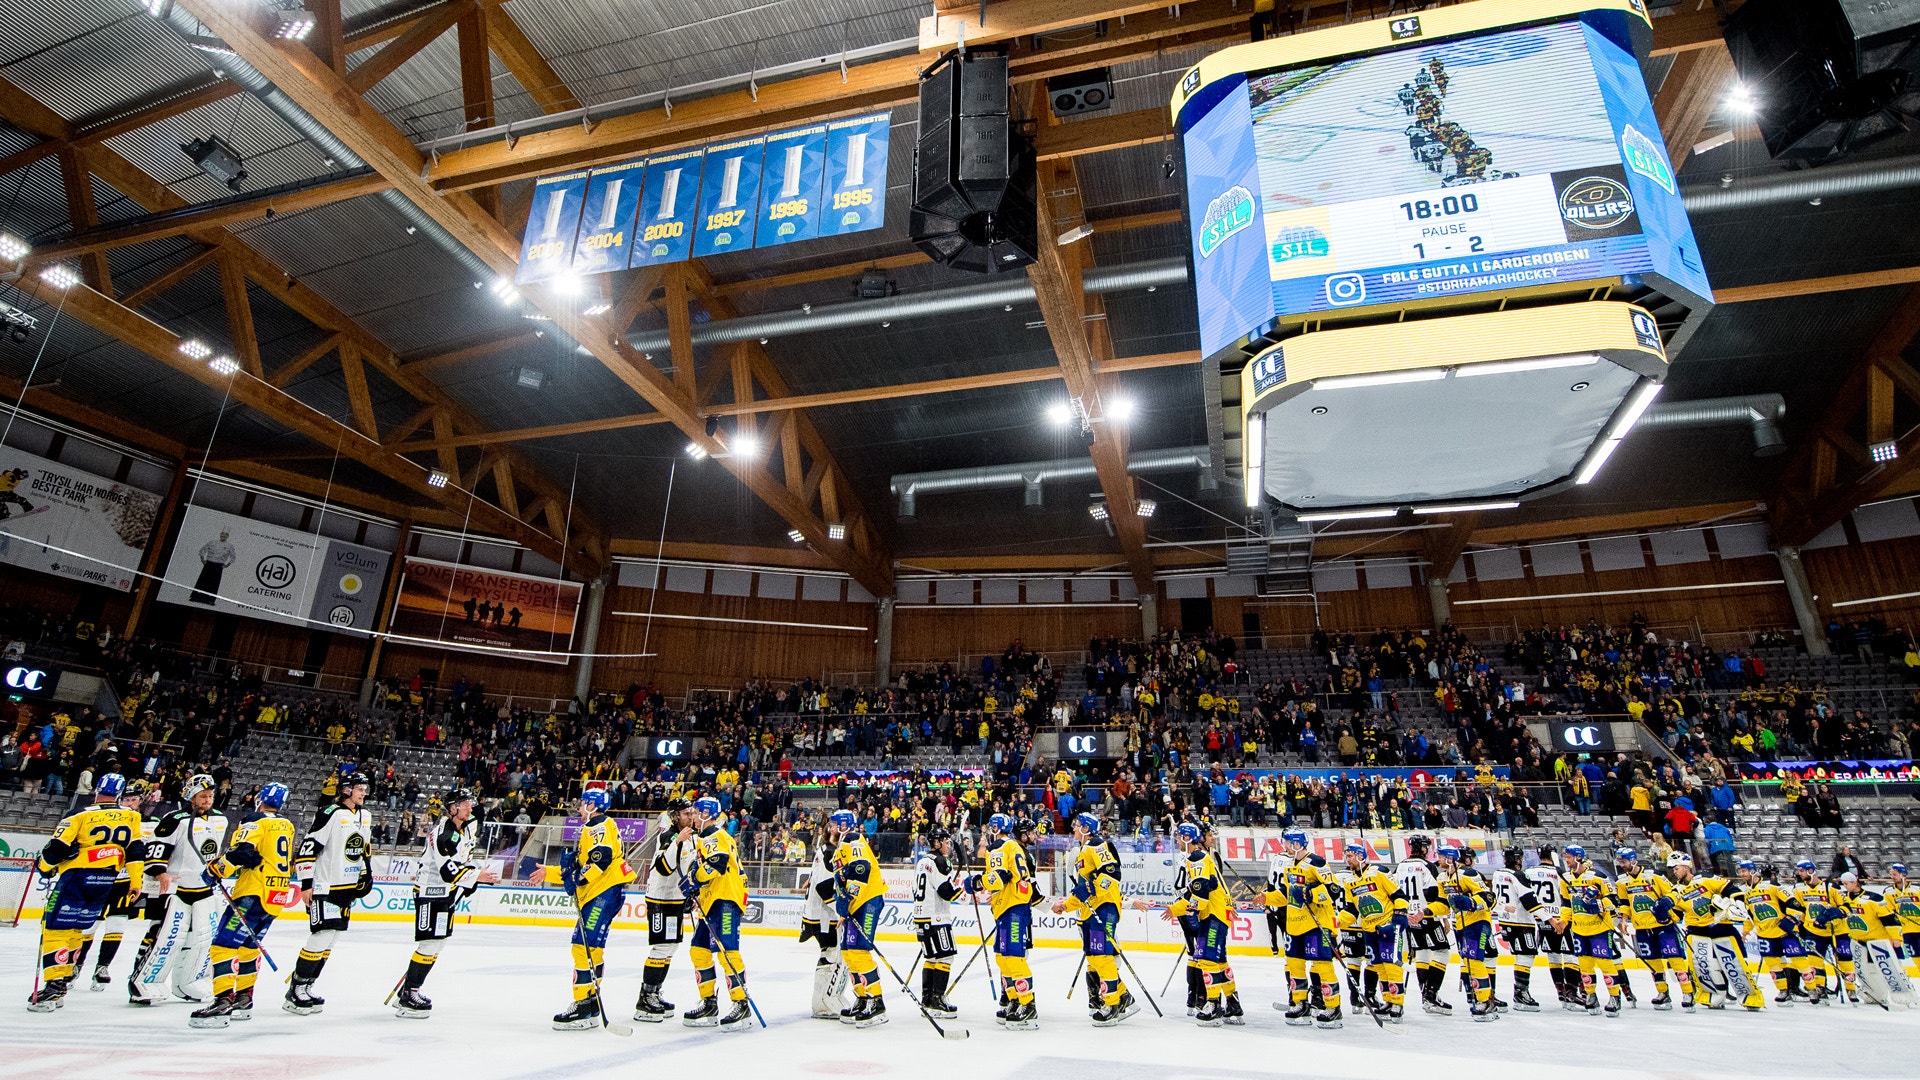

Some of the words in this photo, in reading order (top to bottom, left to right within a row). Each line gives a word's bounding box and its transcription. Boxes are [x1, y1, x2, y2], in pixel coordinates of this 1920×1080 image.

[833, 188, 873, 210] 1995
[1400, 193, 1480, 221] 18:00
[769, 199, 808, 220] 1996
[1564, 200, 1633, 220] OILERS
[706, 210, 746, 231] 1997
[1422, 223, 1467, 238] PAUSE
[585, 231, 624, 250] 2004
[643, 222, 684, 241] 2000
[1413, 243, 1425, 259] 1
[1468, 236, 1485, 254] 2
[1382, 268, 1419, 285] FØLG
[1421, 263, 1470, 281] GUTTA
[1417, 267, 1559, 294] @STORHAMARHOCKEY
[31, 479, 62, 496] BESTE
[74, 480, 94, 495] HAR
[94, 488, 130, 506] NORGES
[404, 562, 557, 596] KONFERANSEROM
[247, 586, 292, 601] CATERING
[1068, 735, 1097, 753] CC
[1564, 726, 1602, 746] CC
[656, 740, 683, 756] CC
[300, 840, 315, 856] 62
[592, 831, 605, 846] 37
[705, 843, 718, 854] 22
[145, 843, 165, 860] 38
[852, 847, 862, 858] 41
[990, 857, 1002, 869] 69
[1405, 875, 1420, 900] 11
[1532, 880, 1556, 904] 73
[586, 906, 602, 930] KIWI
[722, 912, 732, 935] KIWI
[863, 913, 873, 935] KIWI
[1011, 922, 1020, 943] KIWI
[1207, 927, 1217, 948] KIWI
[1592, 945, 1607, 955] eie
[1663, 946, 1677, 955] eie
[1785, 945, 1800, 954] eie
[1721, 955, 1748, 995] ECOSØR
